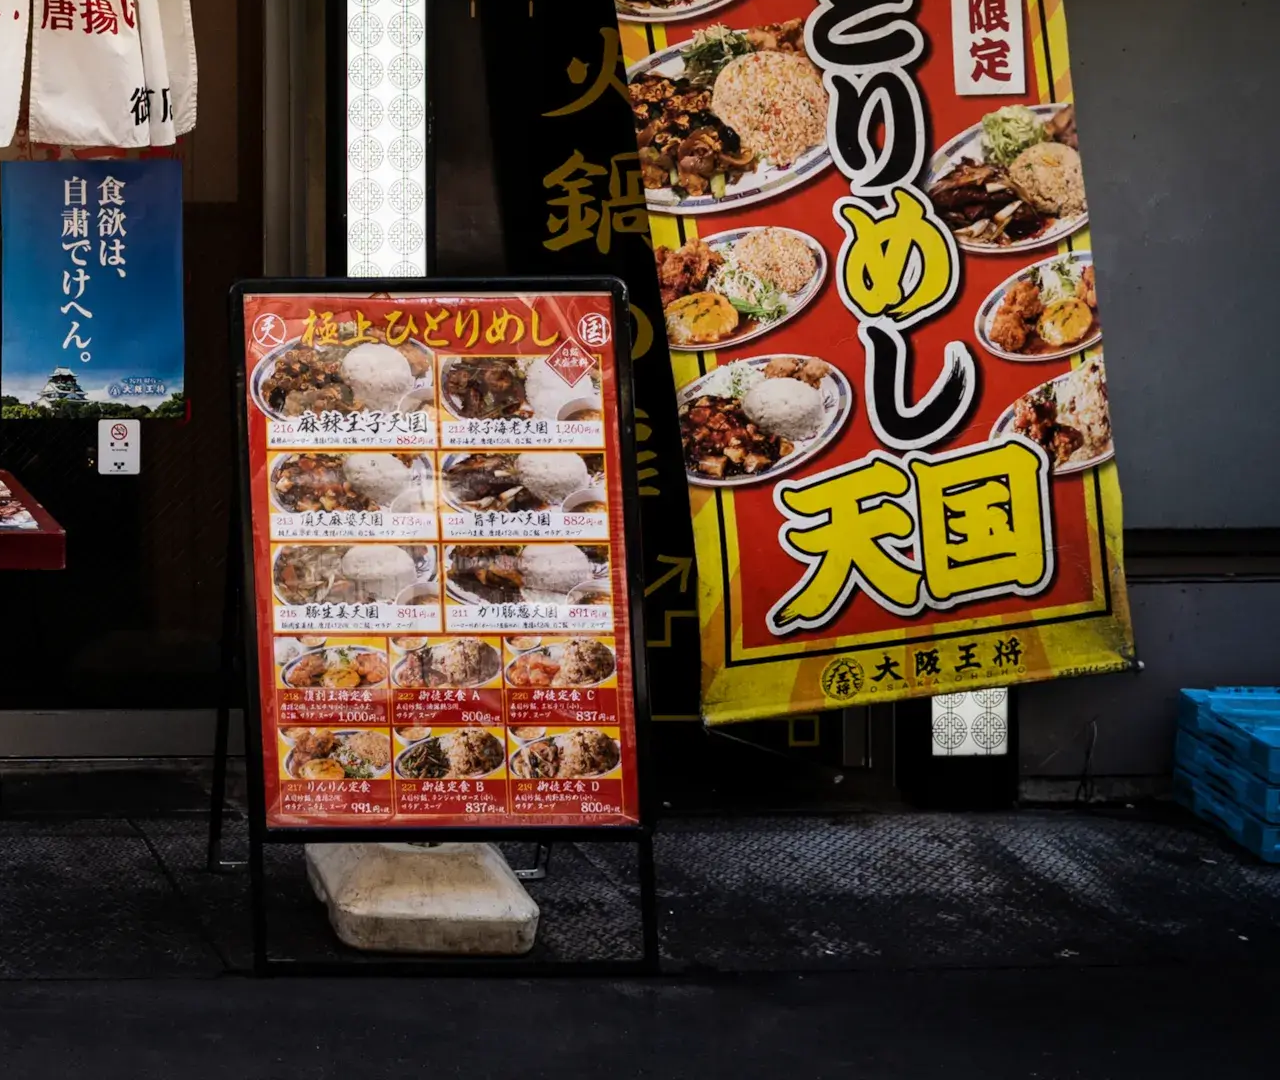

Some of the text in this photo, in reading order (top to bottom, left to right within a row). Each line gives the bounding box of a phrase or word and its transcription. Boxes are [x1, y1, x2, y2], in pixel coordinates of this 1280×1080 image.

[97, 176, 127, 278] 食欲は、
[60, 176, 93, 363] 自粛でけへん。
[302, 307, 559, 348] 極上ひとりめし
[582, 315, 607, 345] 国
[273, 424, 294, 433] 216
[768, 440, 1052, 638] 天国
[871, 636, 1022, 683] 大阪王将
[472, 691, 481, 701] A
[586, 690, 595, 700] C
[476, 781, 484, 792] B
[591, 781, 600, 791] D
